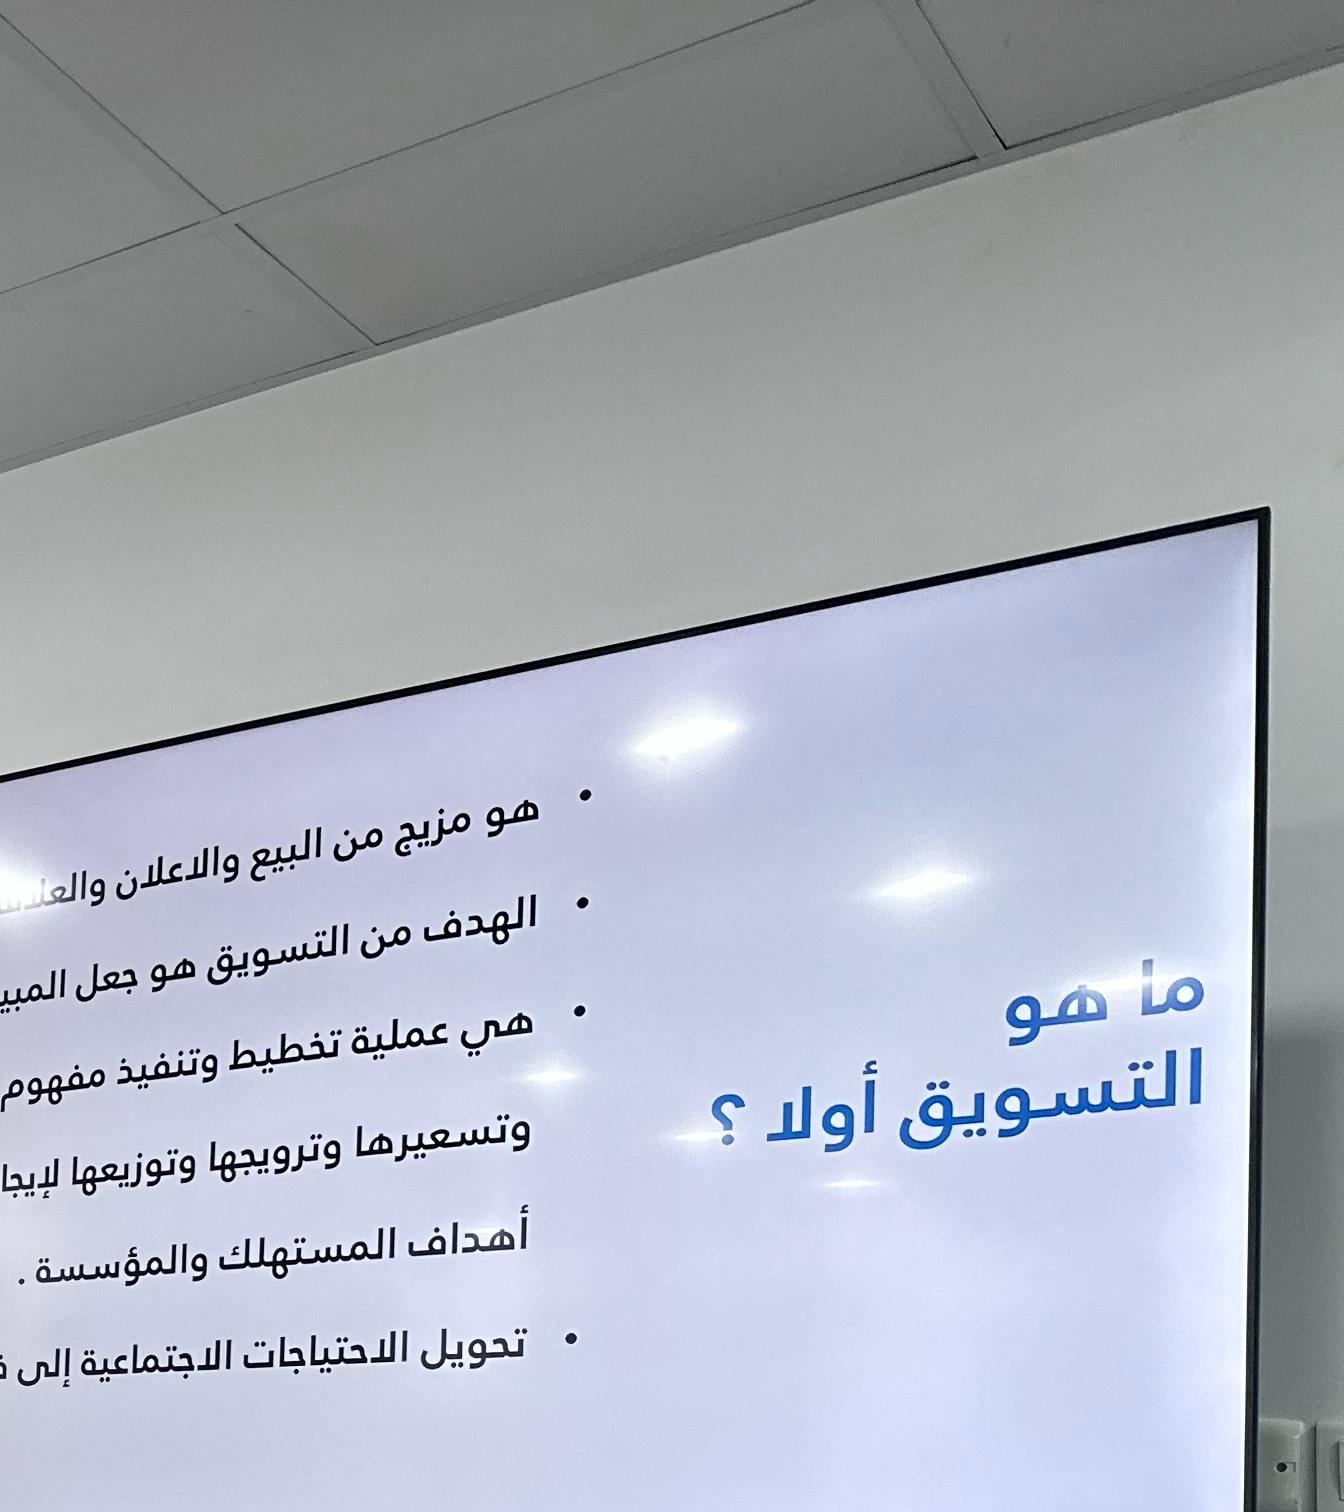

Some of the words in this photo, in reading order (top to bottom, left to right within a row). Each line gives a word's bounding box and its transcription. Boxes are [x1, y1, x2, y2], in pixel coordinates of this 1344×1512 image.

[395, 808, 470, 857] مزيج
[486, 800, 539, 838] هو
[250, 827, 322, 882] البيع
[333, 828, 383, 862] من
[116, 846, 239, 900] والاعلان
[361, 926, 411, 959] من
[424, 894, 536, 945] الهدف
[151, 958, 195, 992] هو
[207, 923, 349, 985] التسويق
[76, 963, 138, 1002] جعل
[1141, 959, 1204, 1015] ما
[351, 1018, 448, 1060] عملية
[461, 1012, 533, 1057] هي
[1006, 985, 1107, 1046] هو
[117, 1048, 218, 1090] وتنفيذ
[229, 1029, 342, 1074] تخطيط
[0, 1065, 105, 1112] مفهوم
[767, 1060, 878, 1152] أولا
[899, 1047, 1202, 1150] التسويق
[210, 1133, 341, 1182] وترويجها
[356, 1114, 530, 1162] وتسعيرها
[72, 1149, 195, 1196] وتوزيعها
[219, 1227, 395, 1279] المستهلك
[408, 1204, 528, 1256] أهداف
[36, 1243, 207, 1286] والمؤسسة
[17, 1348, 70, 1387] إلى
[81, 1339, 232, 1383] الاجتماعية
[243, 1330, 408, 1375] الاحتياجات
[421, 1328, 528, 1370] تحويل
